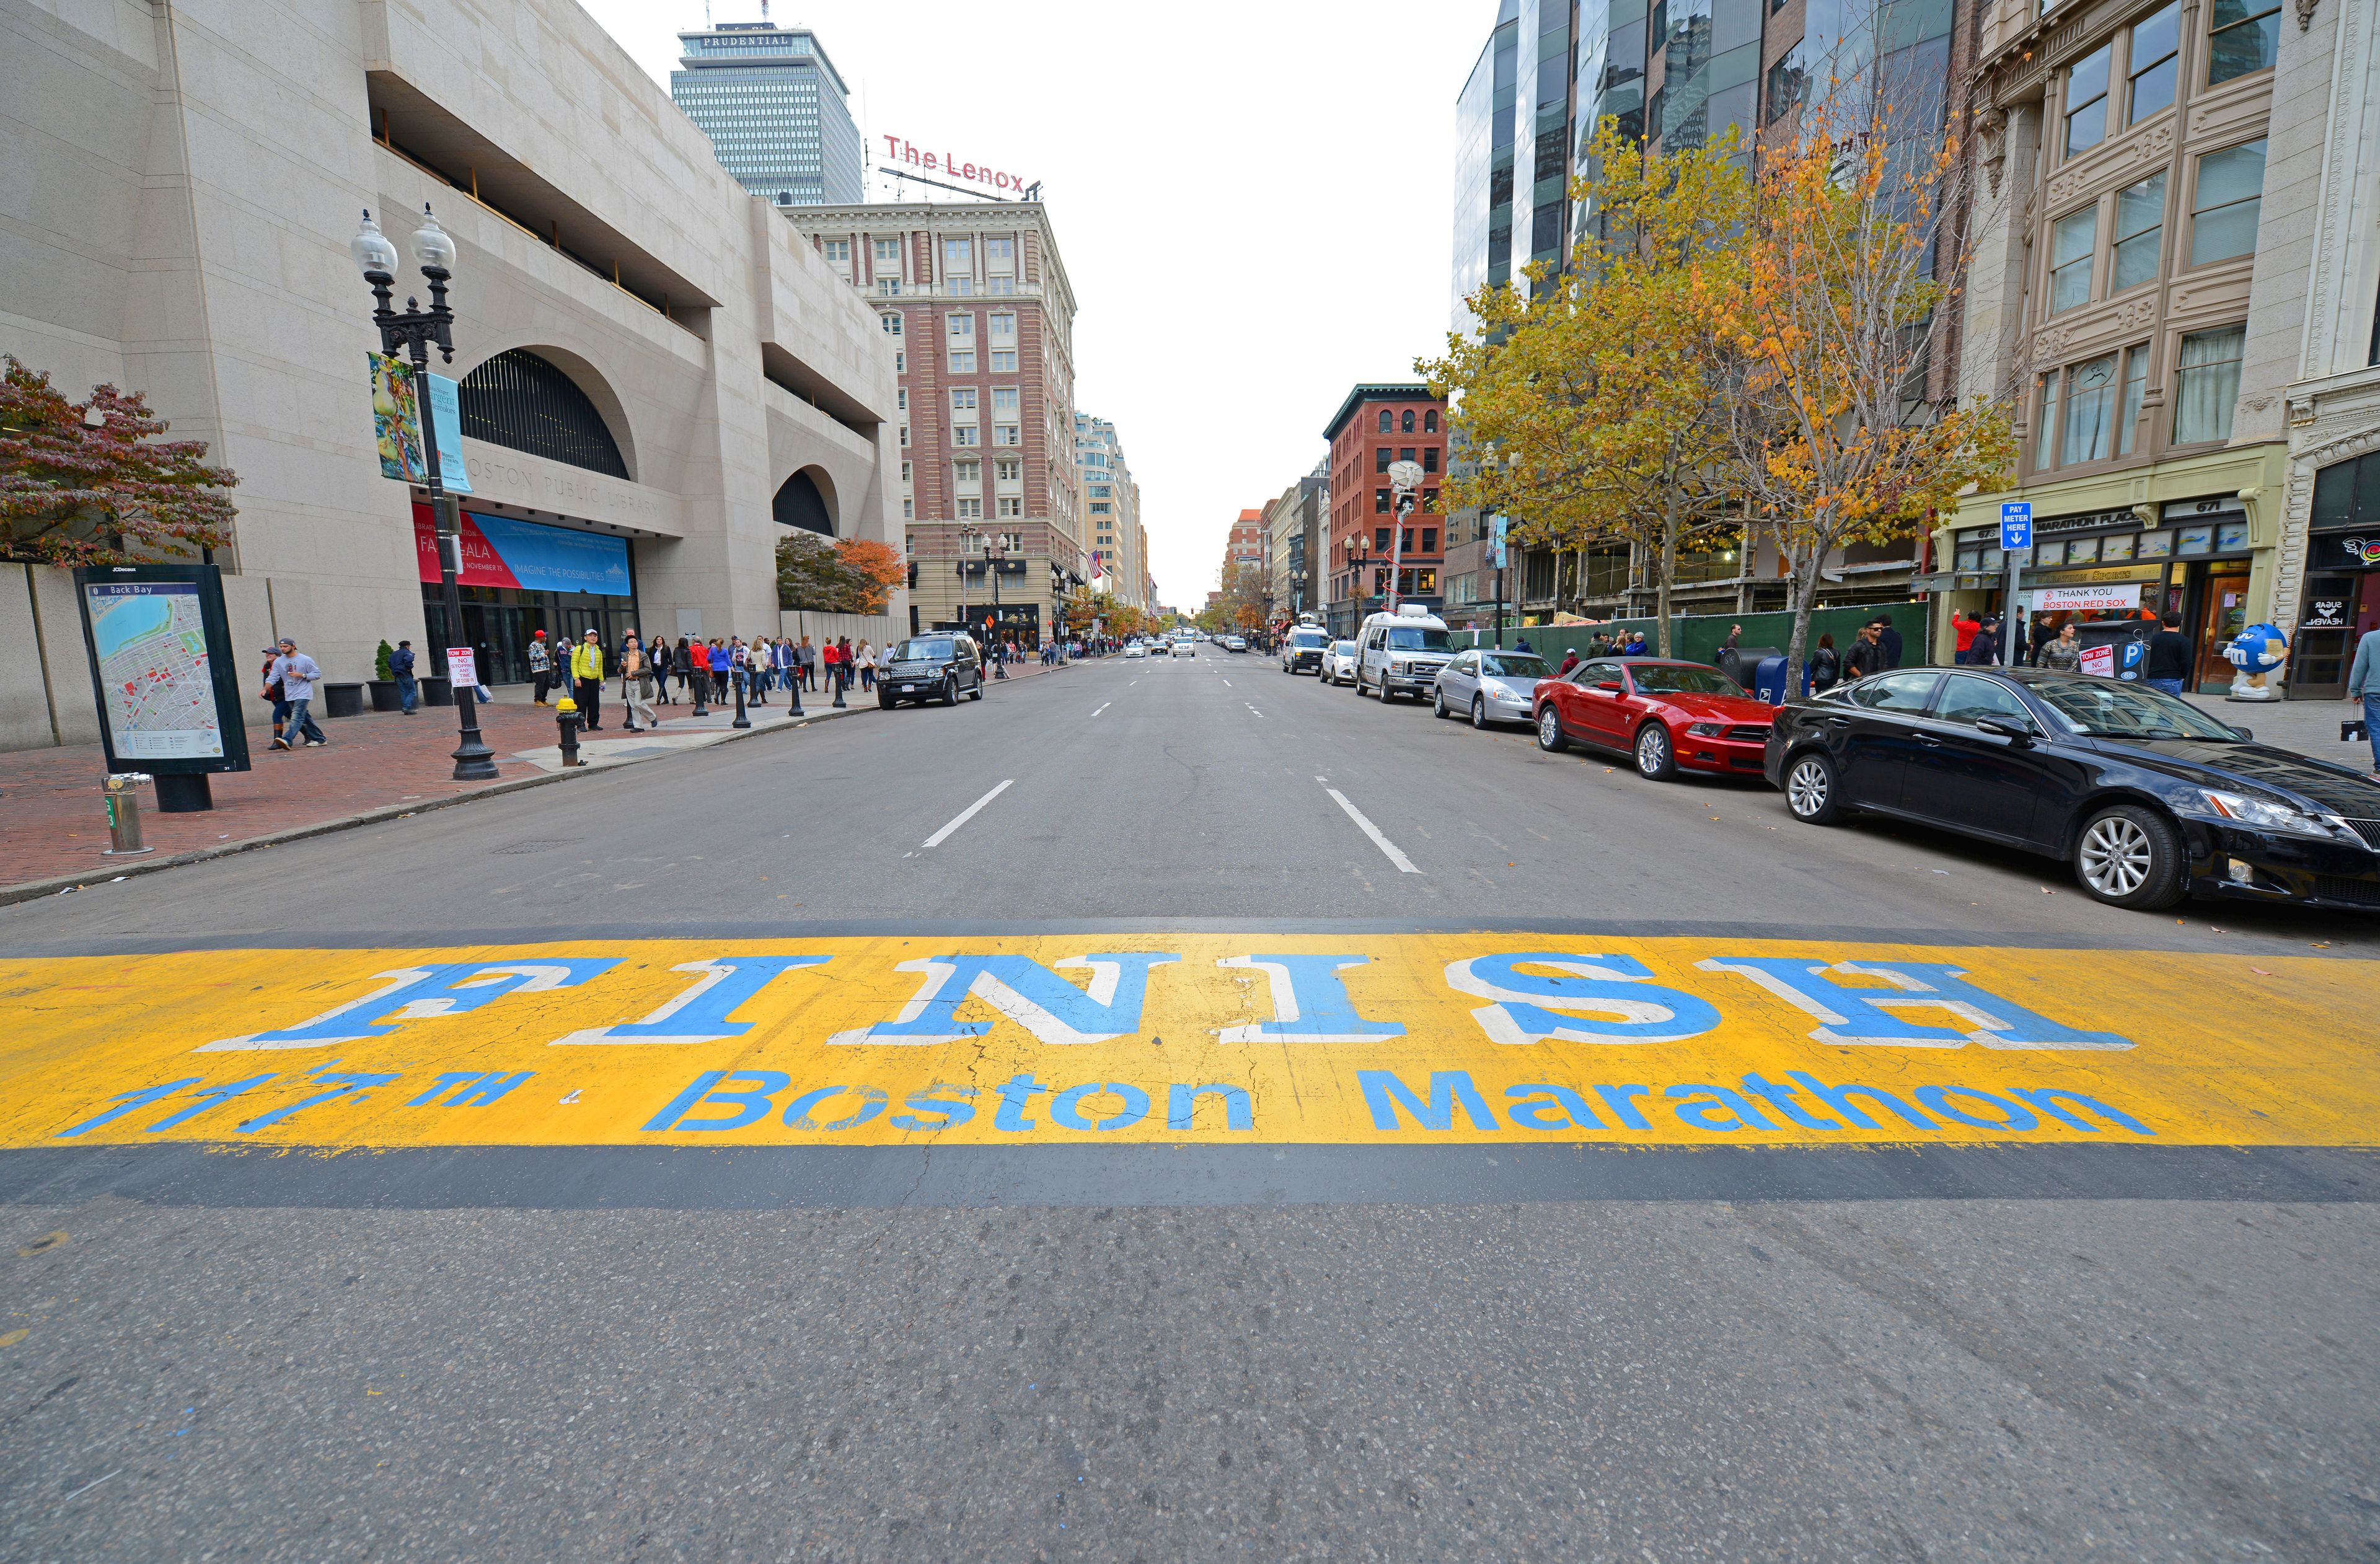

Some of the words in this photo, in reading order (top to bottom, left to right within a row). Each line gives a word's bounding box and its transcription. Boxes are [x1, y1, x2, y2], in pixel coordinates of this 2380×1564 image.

[703, 37, 788, 46] PRUDENTIAL
[884, 134, 937, 170] The
[947, 152, 1024, 193] Lenox
[430, 392, 454, 405] argent
[431, 403, 456, 415] tercolors
[468, 458, 532, 487] OSTON
[545, 477, 600, 503] PUBLIC
[607, 491, 659, 517] LIBRARY
[2196, 501, 2219, 512] 671
[2004, 514, 2029, 522] METER
[2036, 516, 2096, 532] MARATHON
[415, 523, 435, 531] IBRARY
[1978, 529, 1995, 538] 673
[420, 536, 438, 553] FA
[466, 562, 496, 571] NOVEMBER
[514, 564, 546, 576] IMAGINE
[549, 567, 560, 577] THE
[563, 569, 604, 581] POSSIBILITIES
[2037, 573, 2087, 584] MARATHON
[111, 586, 130, 594] Back
[134, 586, 152, 595] Bay
[2058, 589, 2089, 597] THANK
[2093, 588, 2113, 597] YOU
[2043, 600, 2081, 609] BOSTON
[2106, 599, 2127, 607] SOX
[2081, 652, 2094, 661] TOW
[2096, 648, 2110, 657] ZONE
[2126, 646, 2138, 663] P
[2230, 648, 2248, 665] m
[192, 952, 2139, 1052] FINISH
[639, 1070, 1253, 1133] Boston
[1356, 1070, 2157, 1135] Marathon
